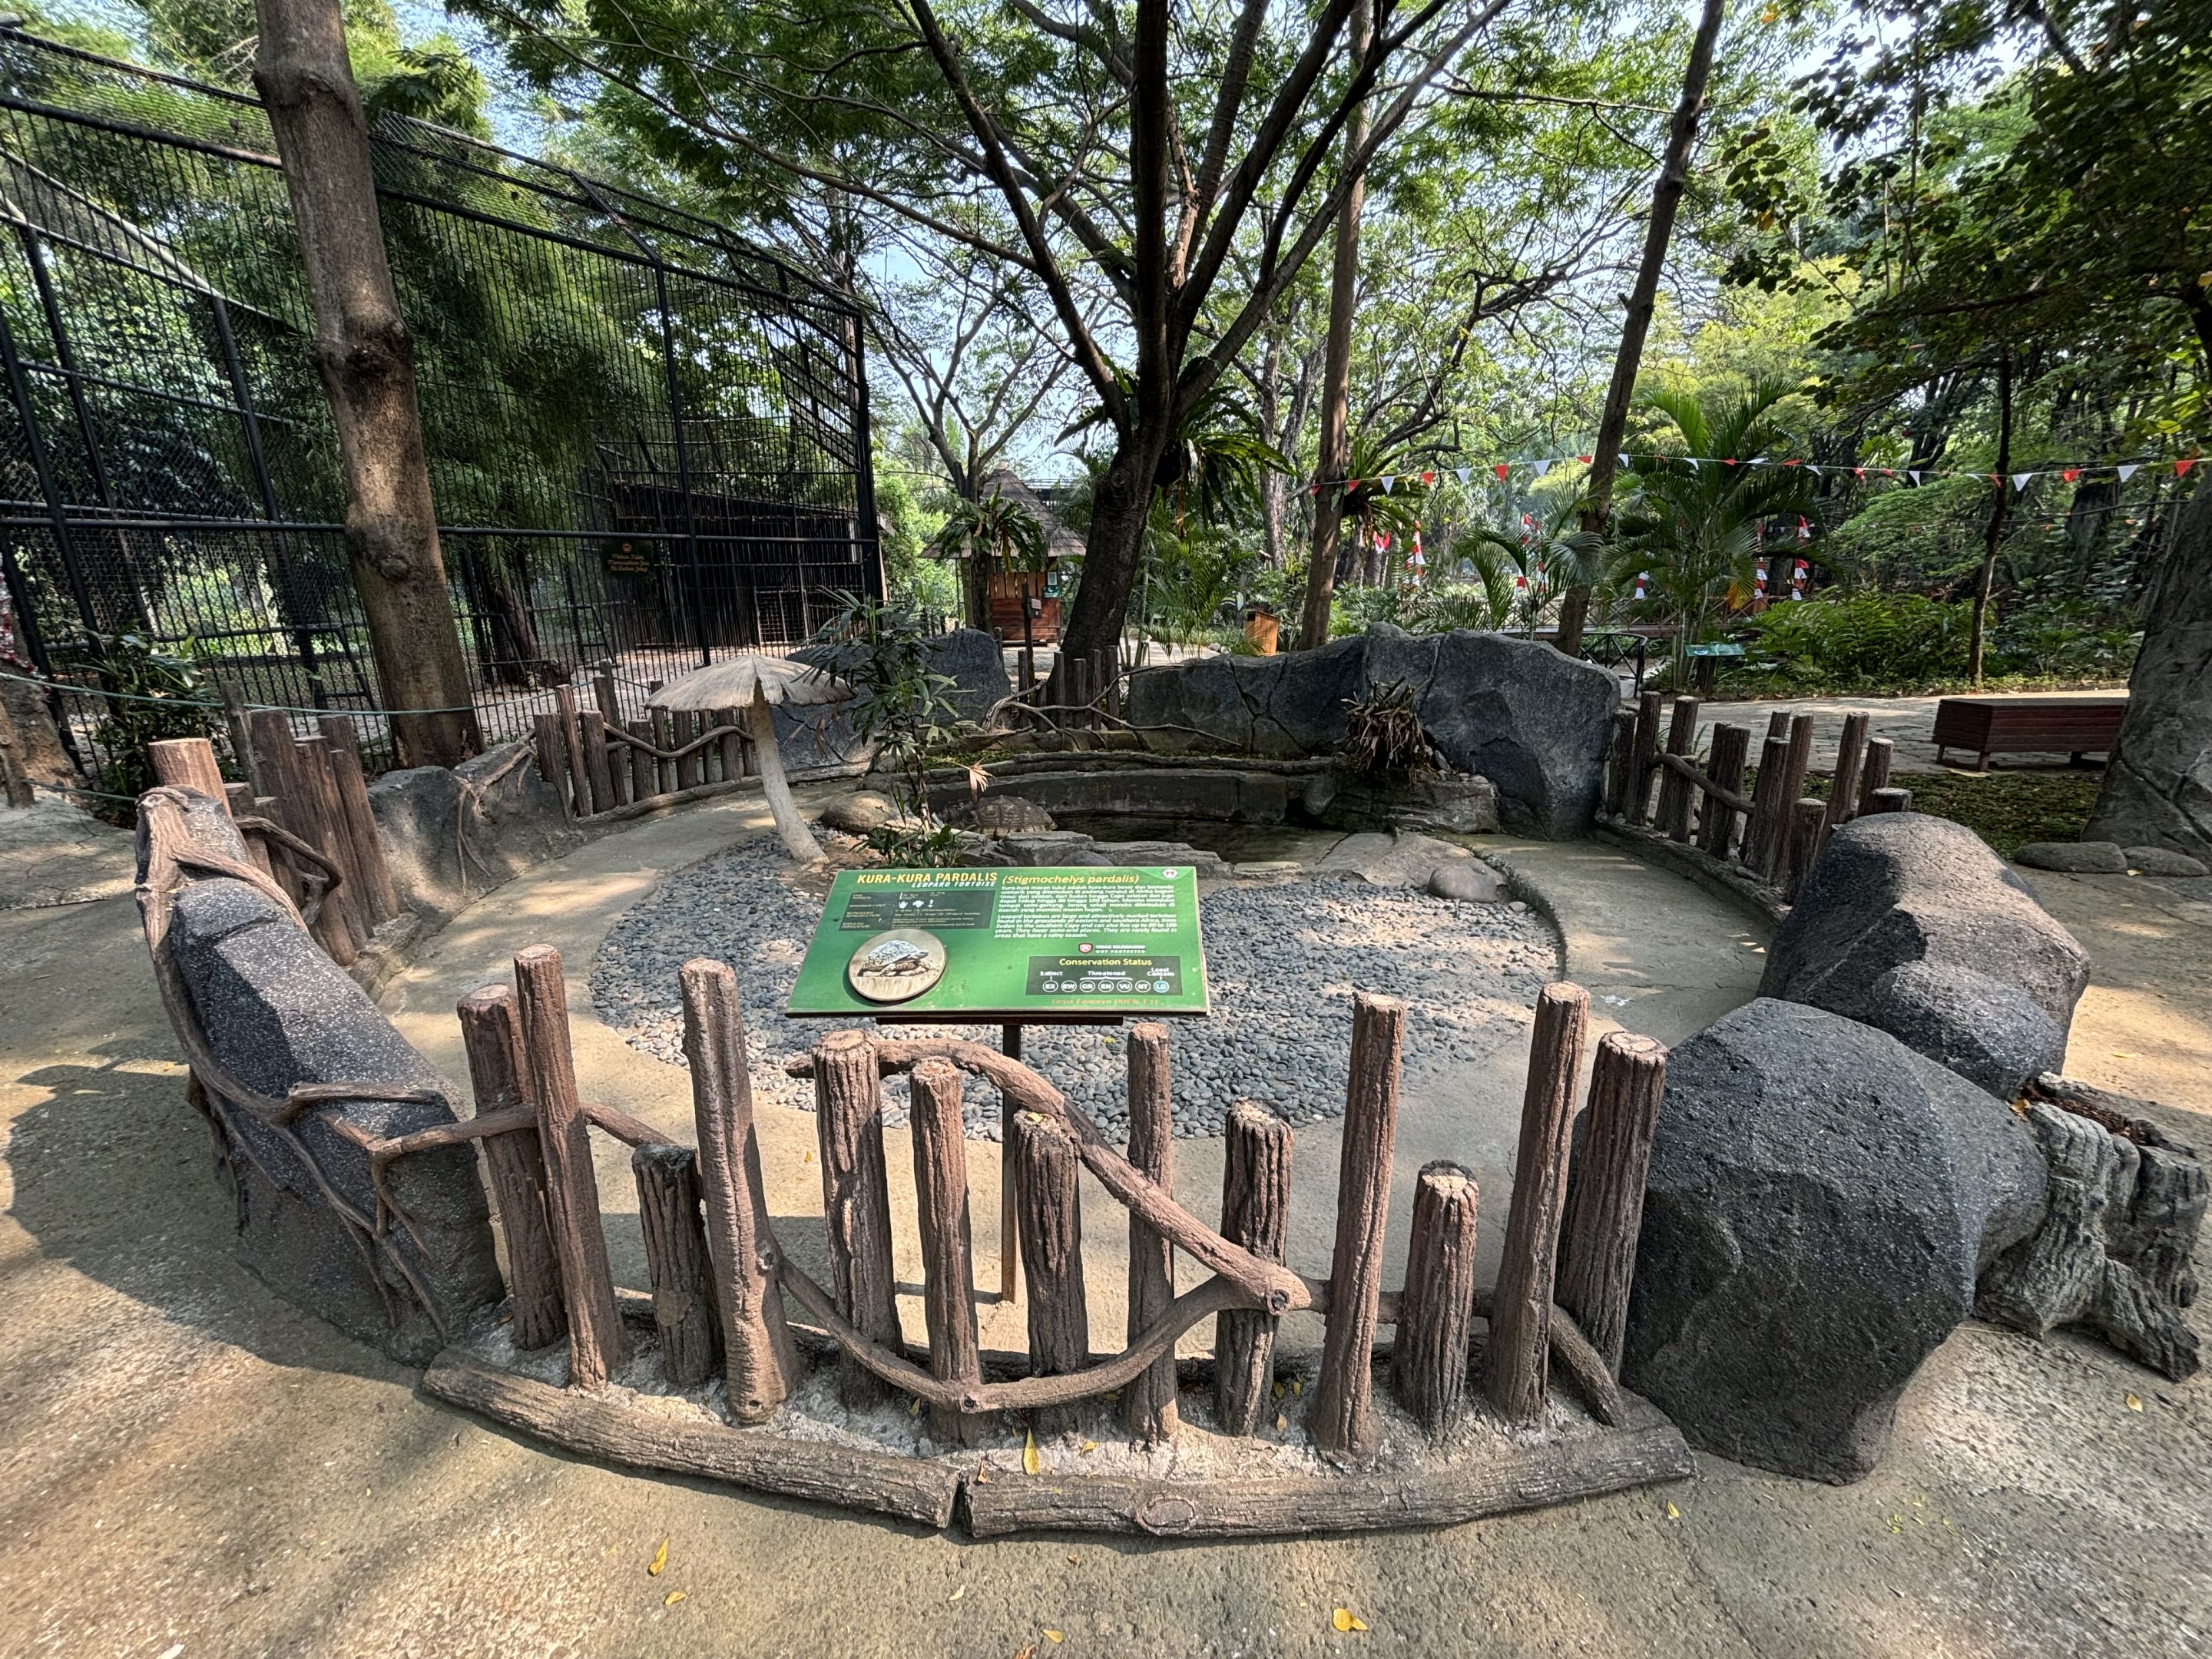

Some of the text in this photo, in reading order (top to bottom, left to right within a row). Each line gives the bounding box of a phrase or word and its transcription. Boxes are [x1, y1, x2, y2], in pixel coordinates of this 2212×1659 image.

[857, 873, 997, 883] KURA-KURA PARDALIS
[1002, 875, 1139, 885] (Stigmochelys pardalis)
